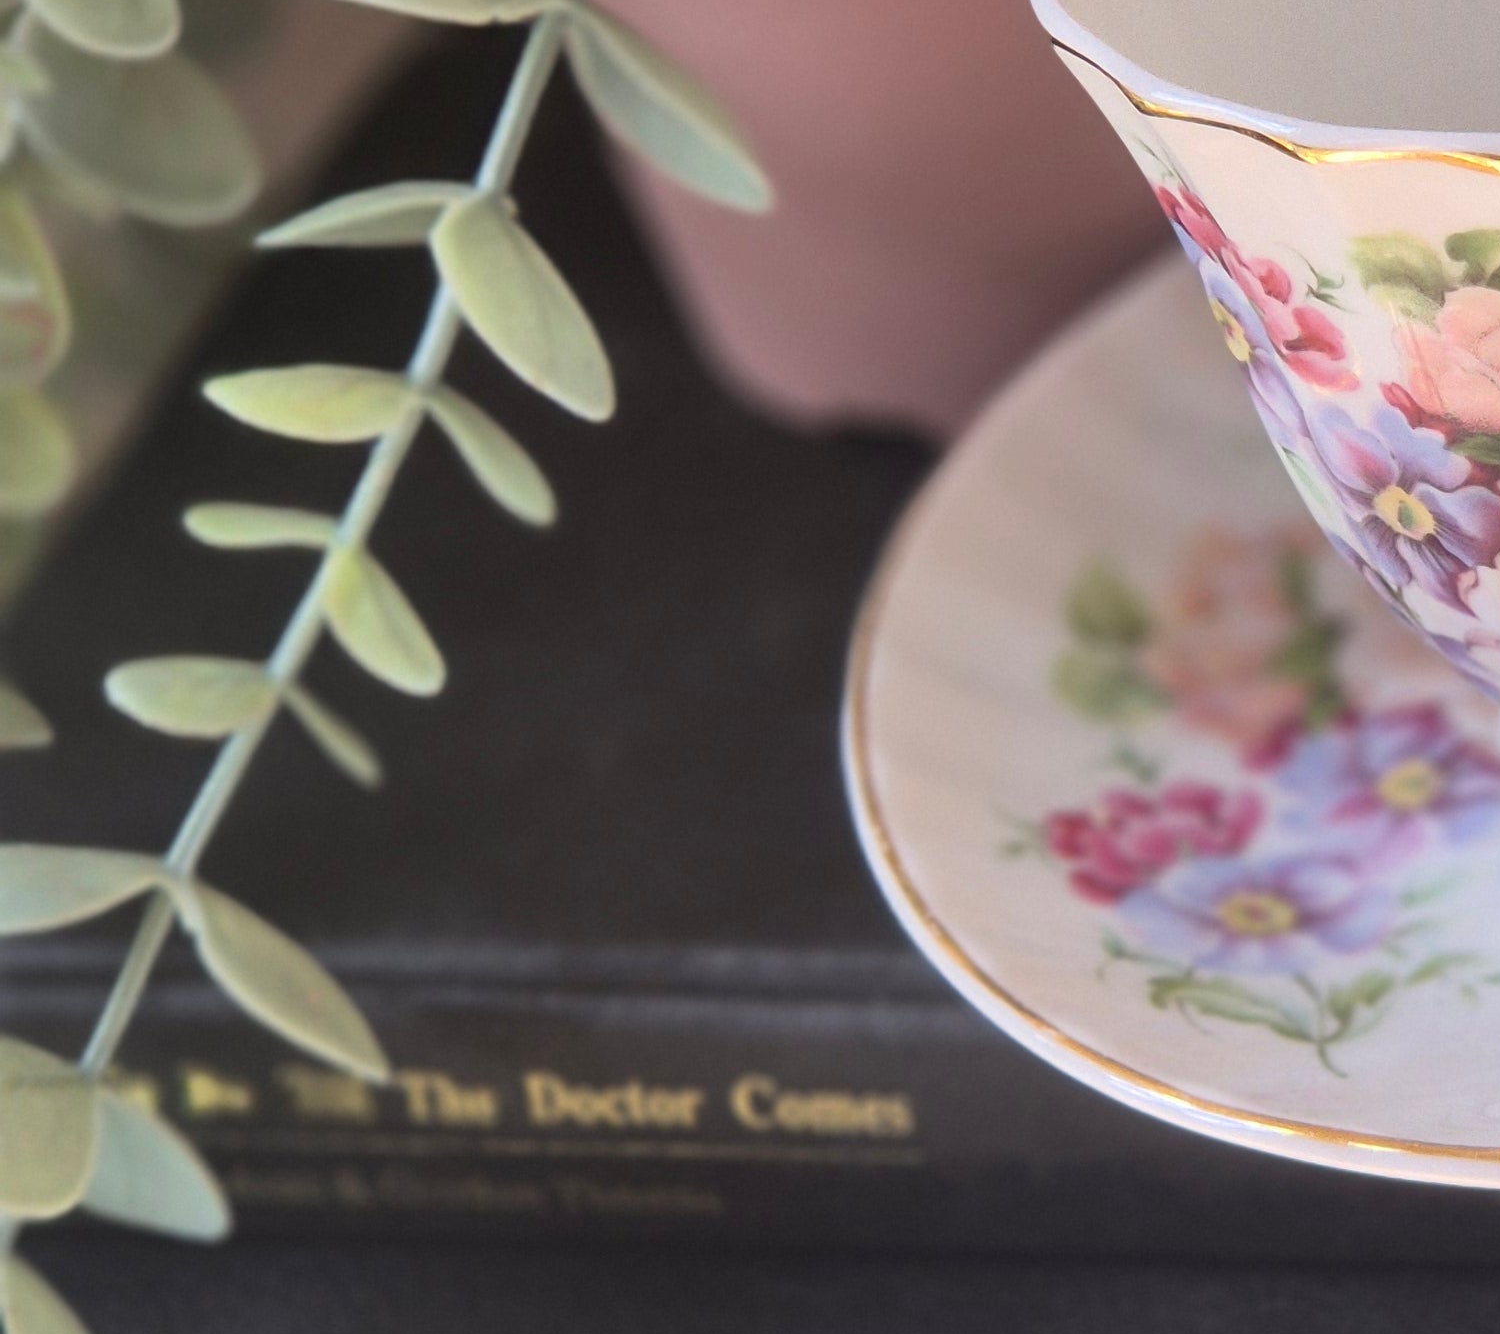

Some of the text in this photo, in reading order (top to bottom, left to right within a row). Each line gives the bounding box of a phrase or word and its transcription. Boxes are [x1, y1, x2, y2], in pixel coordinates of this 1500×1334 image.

[402, 1072, 498, 1131] The
[524, 1072, 703, 1132] Doctor
[730, 1075, 914, 1137] Comes
